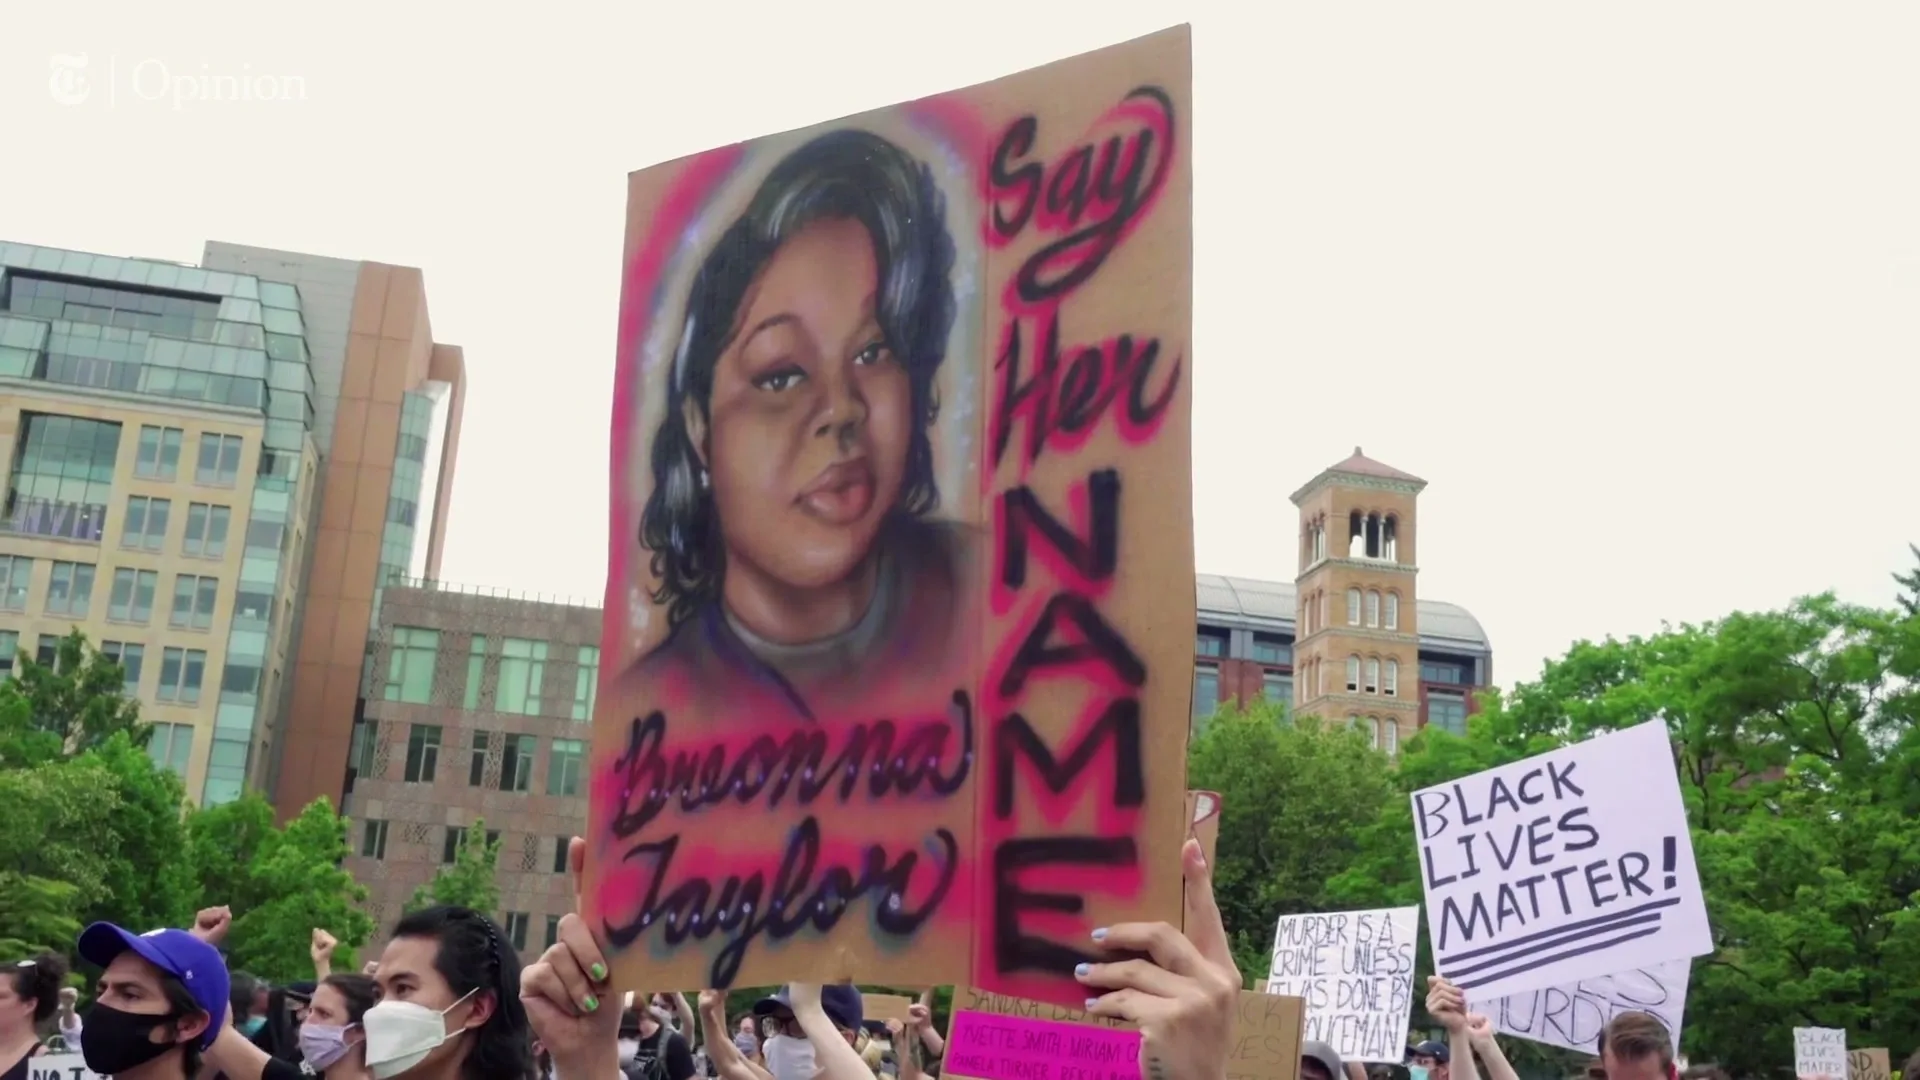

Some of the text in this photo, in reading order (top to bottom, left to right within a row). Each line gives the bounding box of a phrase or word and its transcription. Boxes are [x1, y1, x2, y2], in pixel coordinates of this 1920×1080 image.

[990, 85, 1176, 304] Say
[993, 302, 1182, 470] Her
[994, 468, 1148, 974] NAME
[612, 689, 974, 841] Breonna
[1414, 760, 1585, 841] BLACK
[1423, 806, 1601, 891] LIVES
[603, 815, 958, 990] Taylor
[1278, 911, 1395, 947] MURDER IS A
[1437, 835, 1678, 951] MATTER!
[1271, 942, 1413, 977] CRIME UNLESS
[1336, 977, 1387, 1012] DONE
[1390, 974, 1414, 1019] BY
[952, 1051, 995, 1073] PAMELA
[1000, 1058, 1051, 1080] TURNER
[963, 1024, 1018, 1050] YVETTE
[1021, 1030, 1062, 1058] SMITH
[1069, 1035, 1121, 1064] MIRIAM
